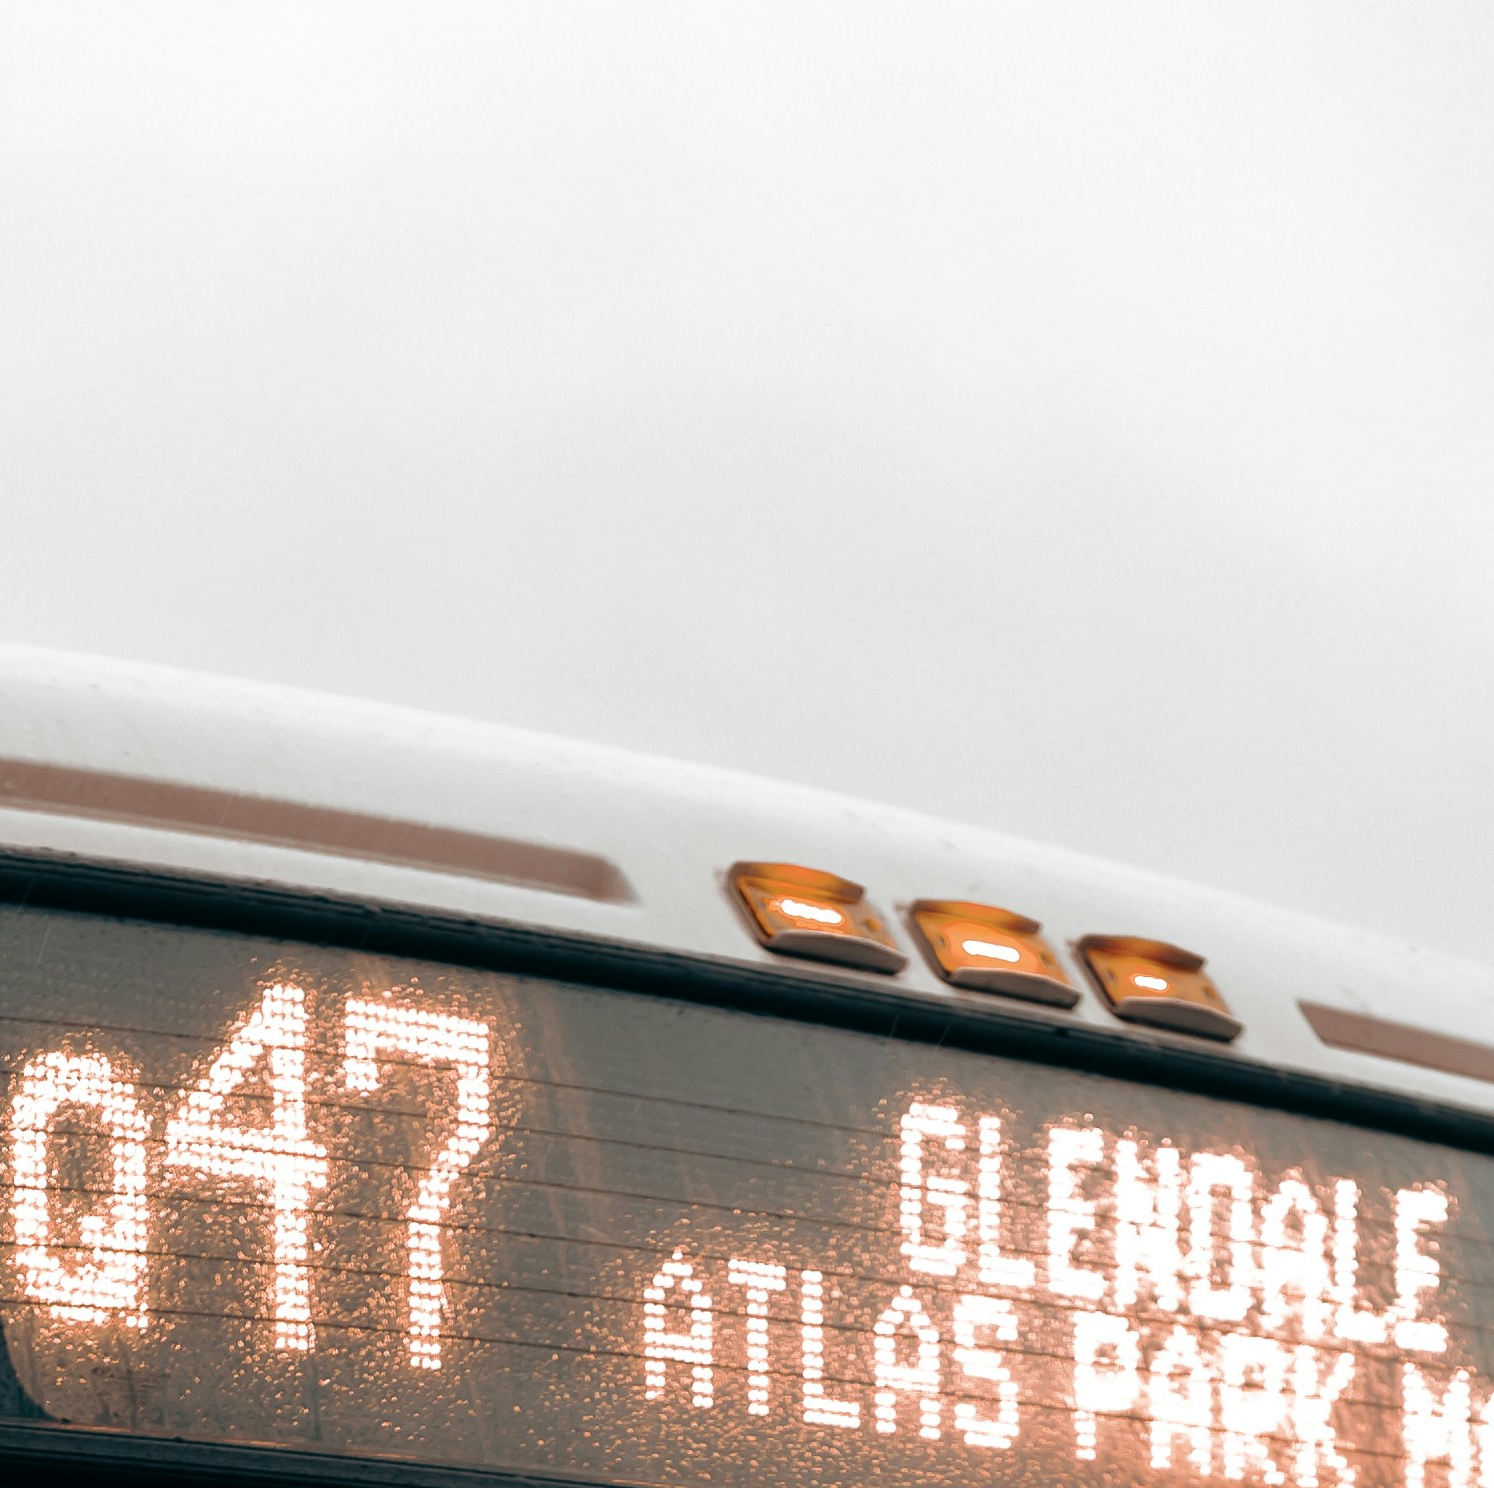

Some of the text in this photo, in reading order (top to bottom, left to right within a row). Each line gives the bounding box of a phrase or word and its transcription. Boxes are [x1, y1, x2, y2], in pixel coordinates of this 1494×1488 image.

[11, 984, 490, 1370] Q47
[901, 1102, 1448, 1351] GLENDALE
[643, 1250, 1019, 1449] ATLAS
